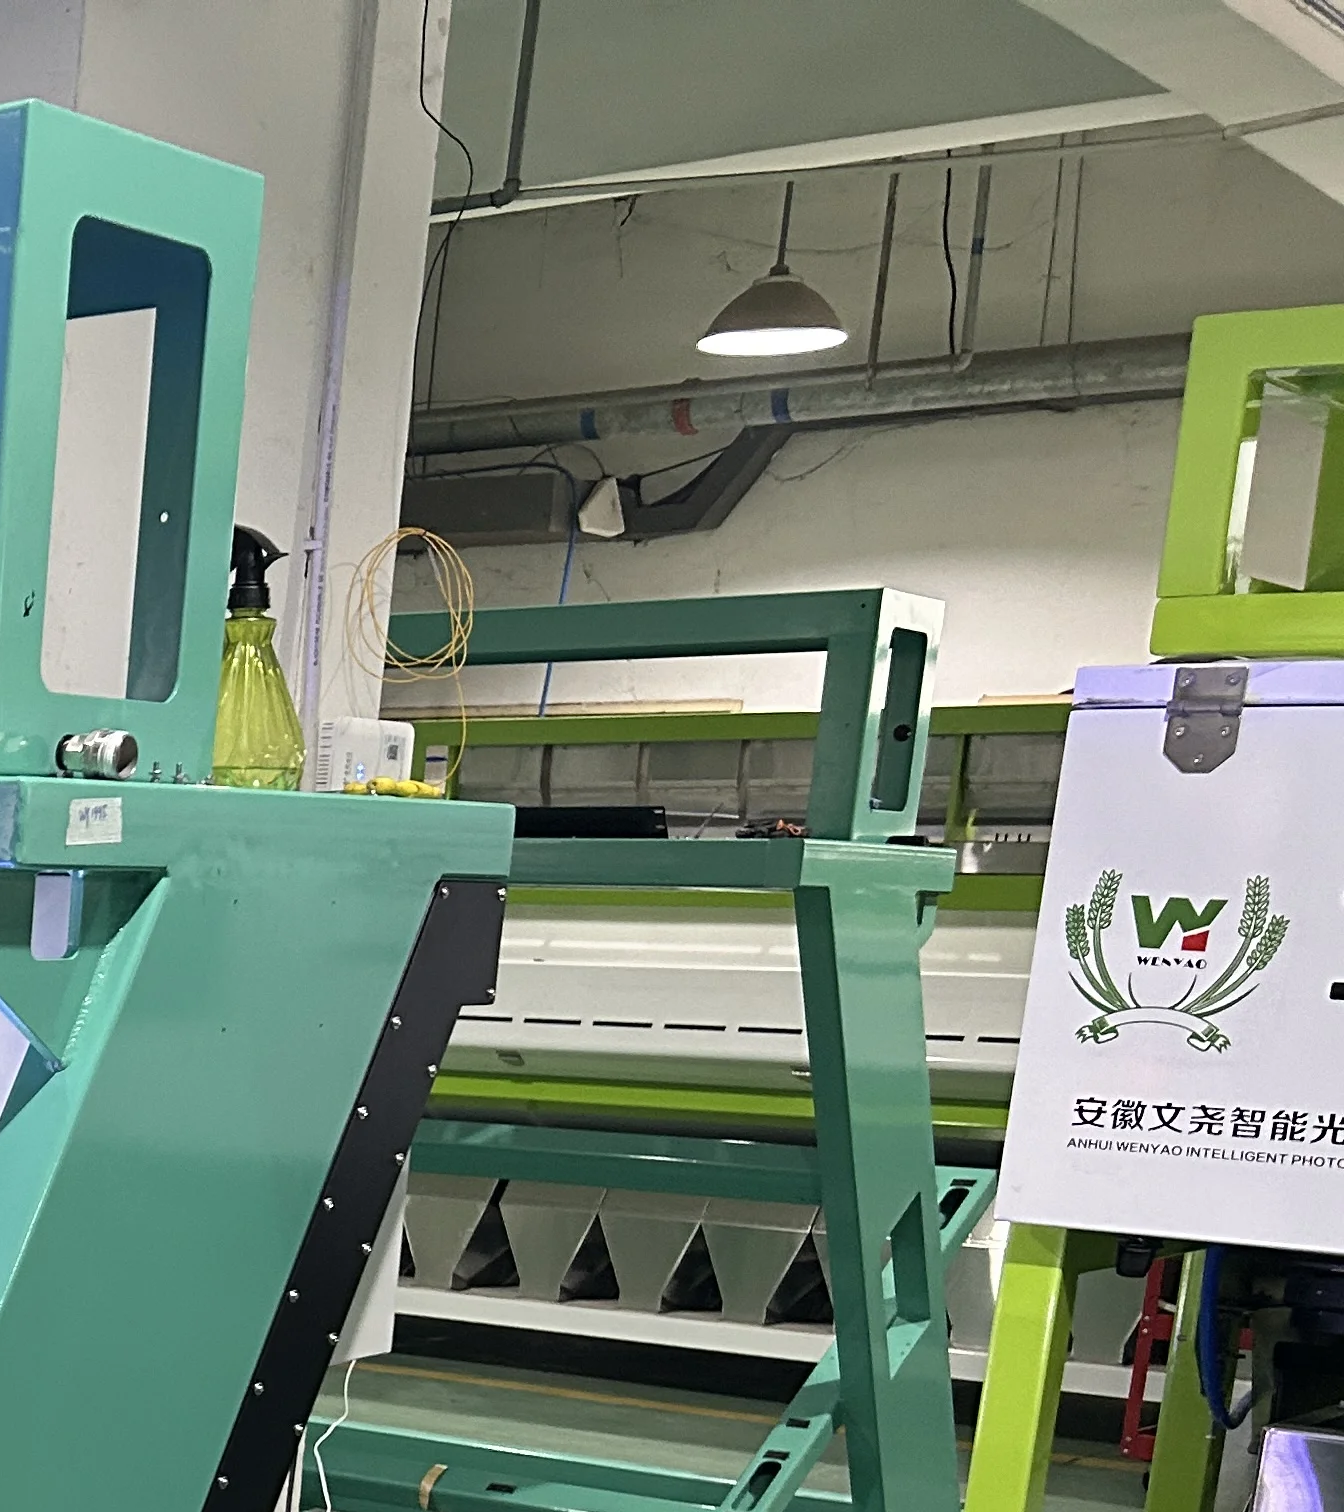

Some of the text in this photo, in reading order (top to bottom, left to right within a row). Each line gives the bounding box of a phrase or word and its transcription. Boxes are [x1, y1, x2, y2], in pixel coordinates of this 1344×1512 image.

[1137, 956, 1208, 969] WENYAO
[1072, 1097, 1344, 1145] 安徽文尧智能光
[1067, 1137, 1113, 1151] ANHUI
[1117, 1141, 1183, 1156] WENYAO
[1186, 1147, 1288, 1165] INTELLIGENT
